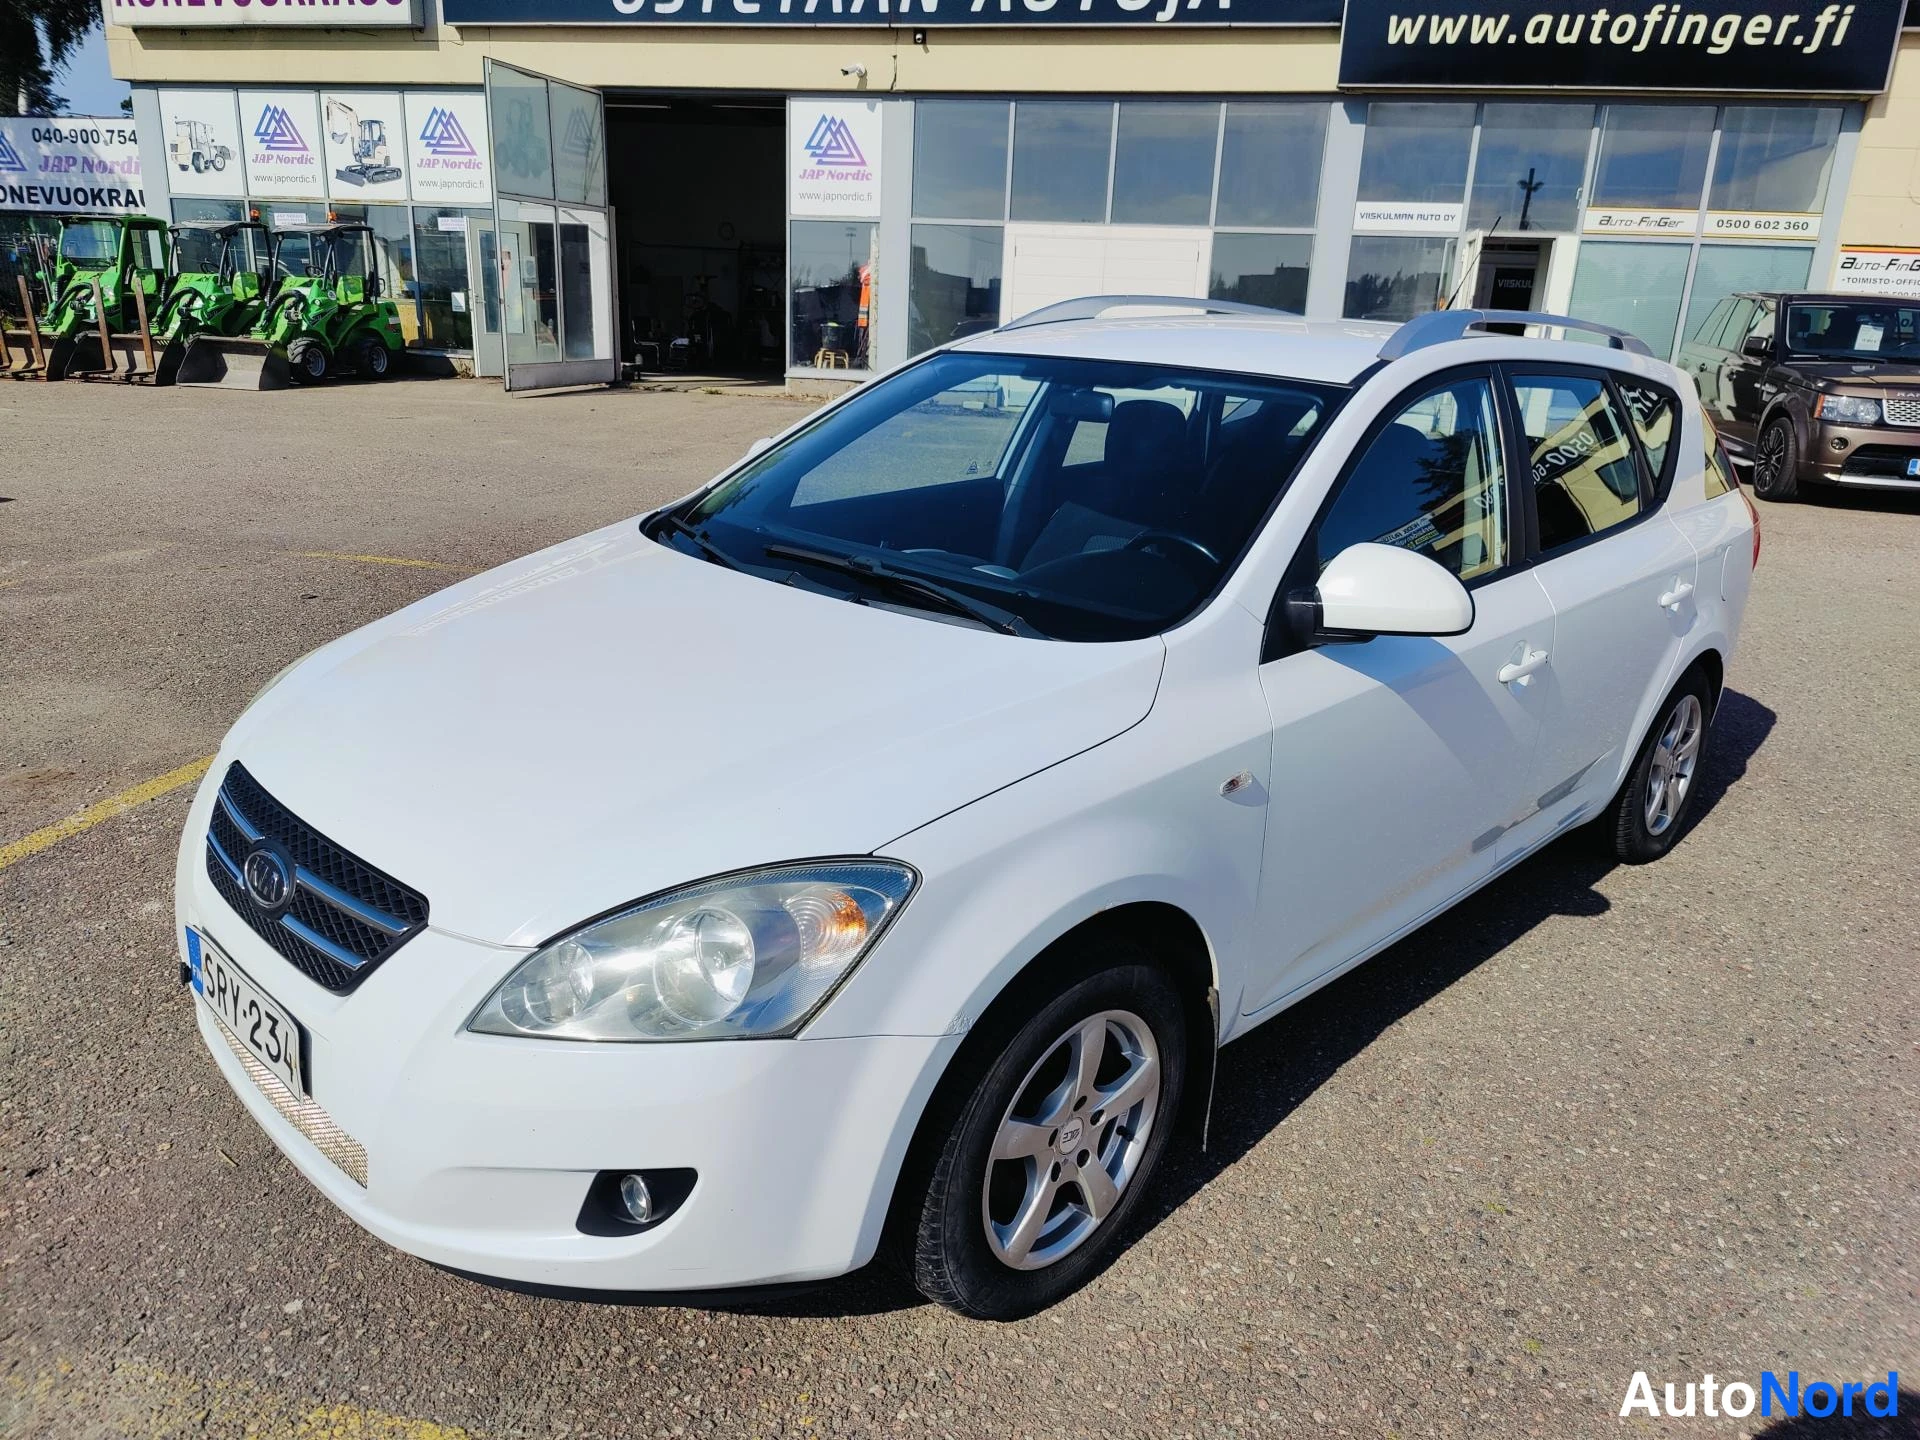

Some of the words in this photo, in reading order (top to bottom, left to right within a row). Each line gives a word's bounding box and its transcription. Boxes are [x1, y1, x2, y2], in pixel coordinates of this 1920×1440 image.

[1387, 4, 1855, 54] www.autofinger.fi
[31, 127, 100, 144] 040-900
[39, 155, 77, 173] JAP
[252, 153, 274, 165] JAP
[276, 154, 315, 165] Nordic
[417, 158, 440, 168] JAP
[442, 158, 483, 170] Nordic
[254, 175, 317, 185] www.japnordic.fi
[799, 168, 825, 180] JAP
[827, 169, 873, 181] Nordic
[418, 179, 485, 190] www.japnordic.fi
[799, 191, 873, 202] www.japnordic.fi
[1360, 212, 1413, 220] VIISKULMAN
[1416, 213, 1441, 221] AUTO
[1443, 214, 1456, 222] OY
[1716, 219, 1750, 230] 0500
[1754, 220, 1780, 231] 602
[1783, 221, 1809, 231] 360
[205, 952, 294, 1083] SRY-234
